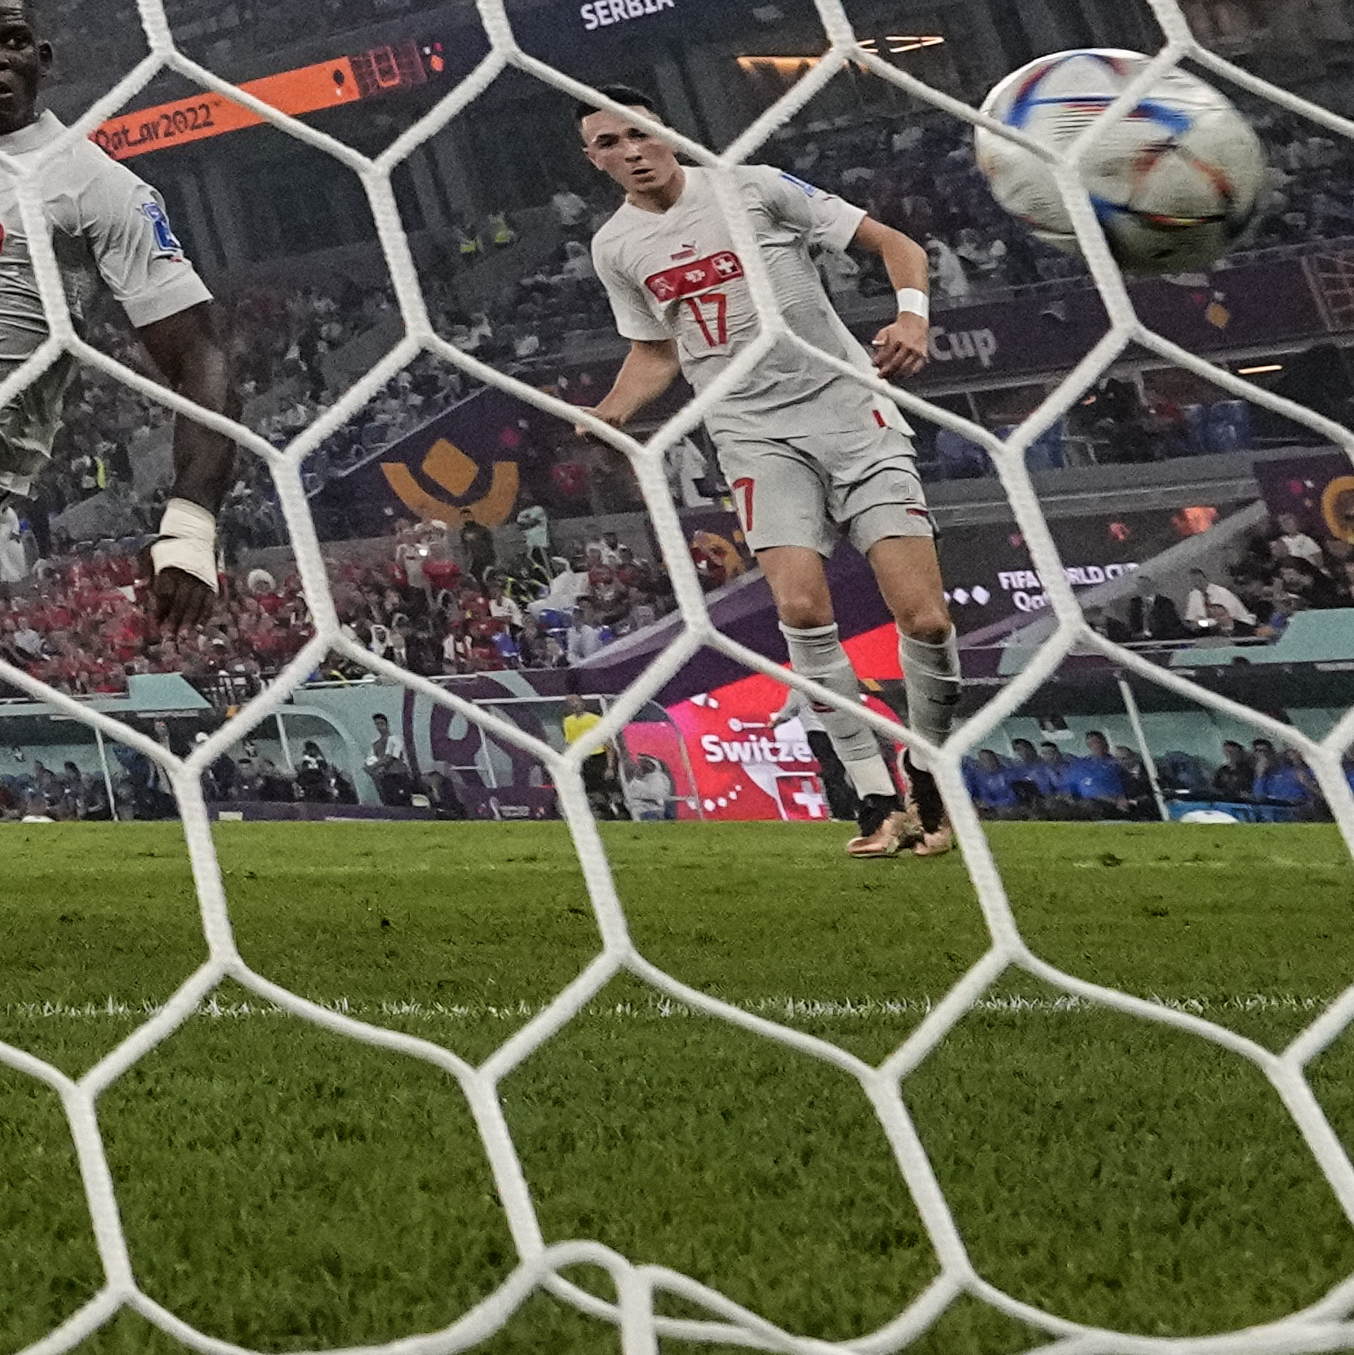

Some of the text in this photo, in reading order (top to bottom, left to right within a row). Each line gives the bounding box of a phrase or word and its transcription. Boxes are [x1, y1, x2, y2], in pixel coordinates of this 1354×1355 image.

[685, 293, 728, 348] 17
[928, 326, 999, 368] Cup
[998, 570, 1041, 590] FIFA
